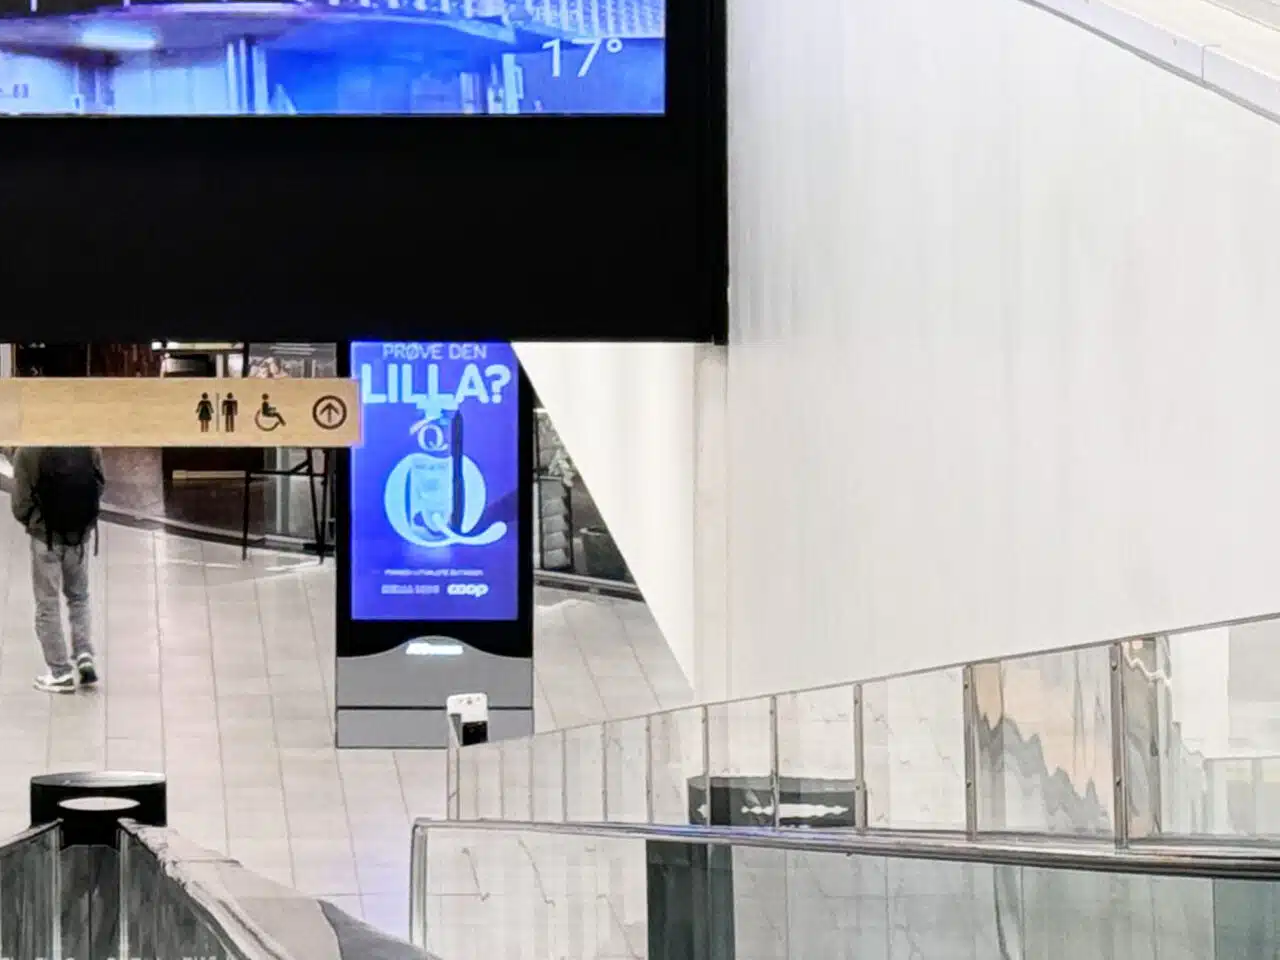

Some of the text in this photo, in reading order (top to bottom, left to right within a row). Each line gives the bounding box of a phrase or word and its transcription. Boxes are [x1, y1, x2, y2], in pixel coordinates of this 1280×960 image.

[541, 37, 623, 78] 17°
[382, 343, 488, 360] PRØVE DEN
[361, 363, 512, 404] LILLA?
